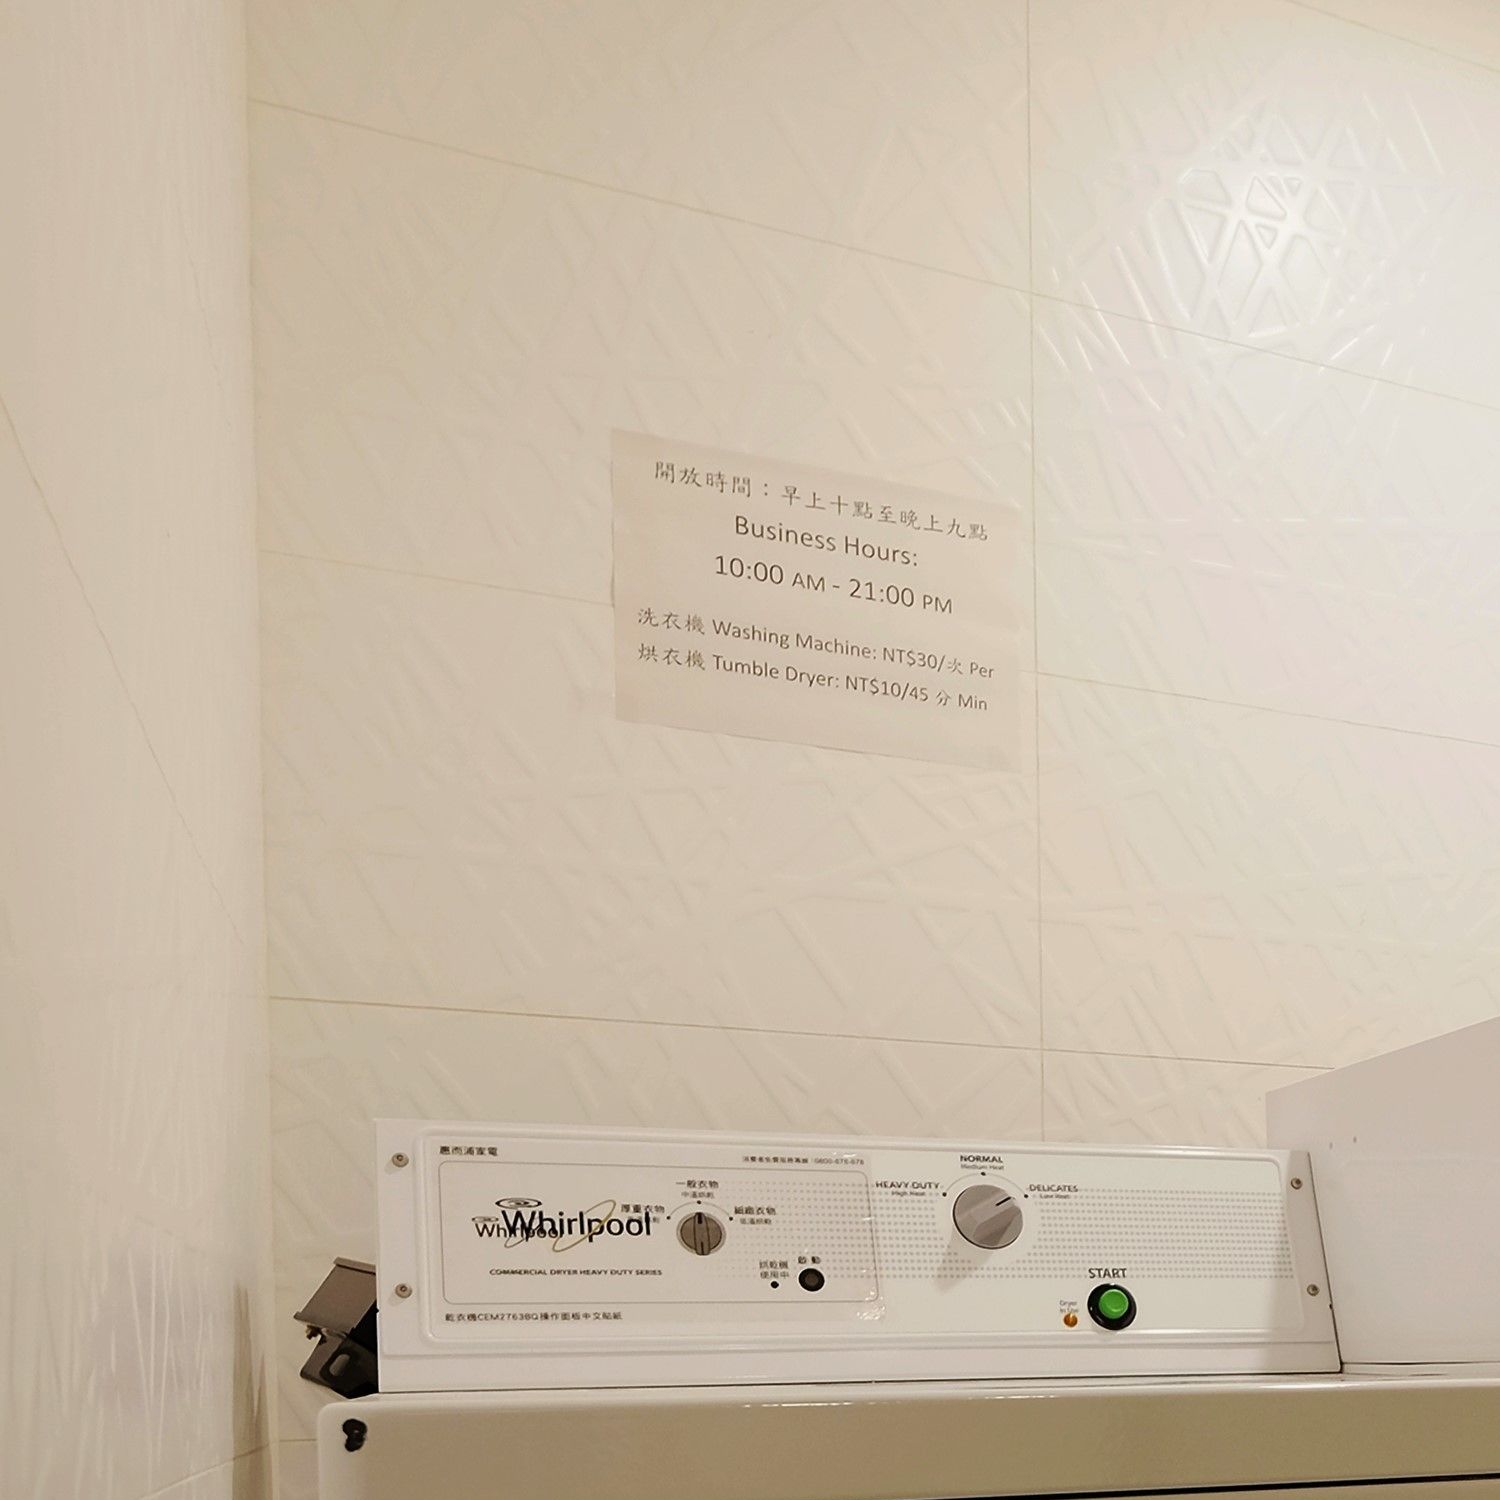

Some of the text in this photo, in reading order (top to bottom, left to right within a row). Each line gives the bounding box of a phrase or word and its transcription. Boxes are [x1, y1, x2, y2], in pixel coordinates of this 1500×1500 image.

[654, 460, 989, 541] 開放時間：早上十點至晚上九點
[735, 515, 919, 567] Business Hours:
[715, 556, 784, 585] 10:00
[791, 572, 826, 592] AM
[848, 579, 915, 608] 21:00
[922, 594, 953, 614] PM
[637, 608, 706, 635] 洗衣機
[712, 618, 790, 649] Washing
[795, 632, 877, 661] Machine:
[970, 662, 995, 679] Per
[637, 643, 988, 711] 烘衣機 Tumble Dryer: NT$10/45 分 Min
[960, 1155, 1003, 1164] NORMAL
[875, 1181, 940, 1190] HEAVY DUTY
[1029, 1184, 1078, 1193] DELICATES
[501, 1210, 651, 1243] Whirlpool
[489, 1268, 547, 1276] COMMERCIAL
[550, 1268, 578, 1276] DRYER
[1088, 1268, 1127, 1279] START
